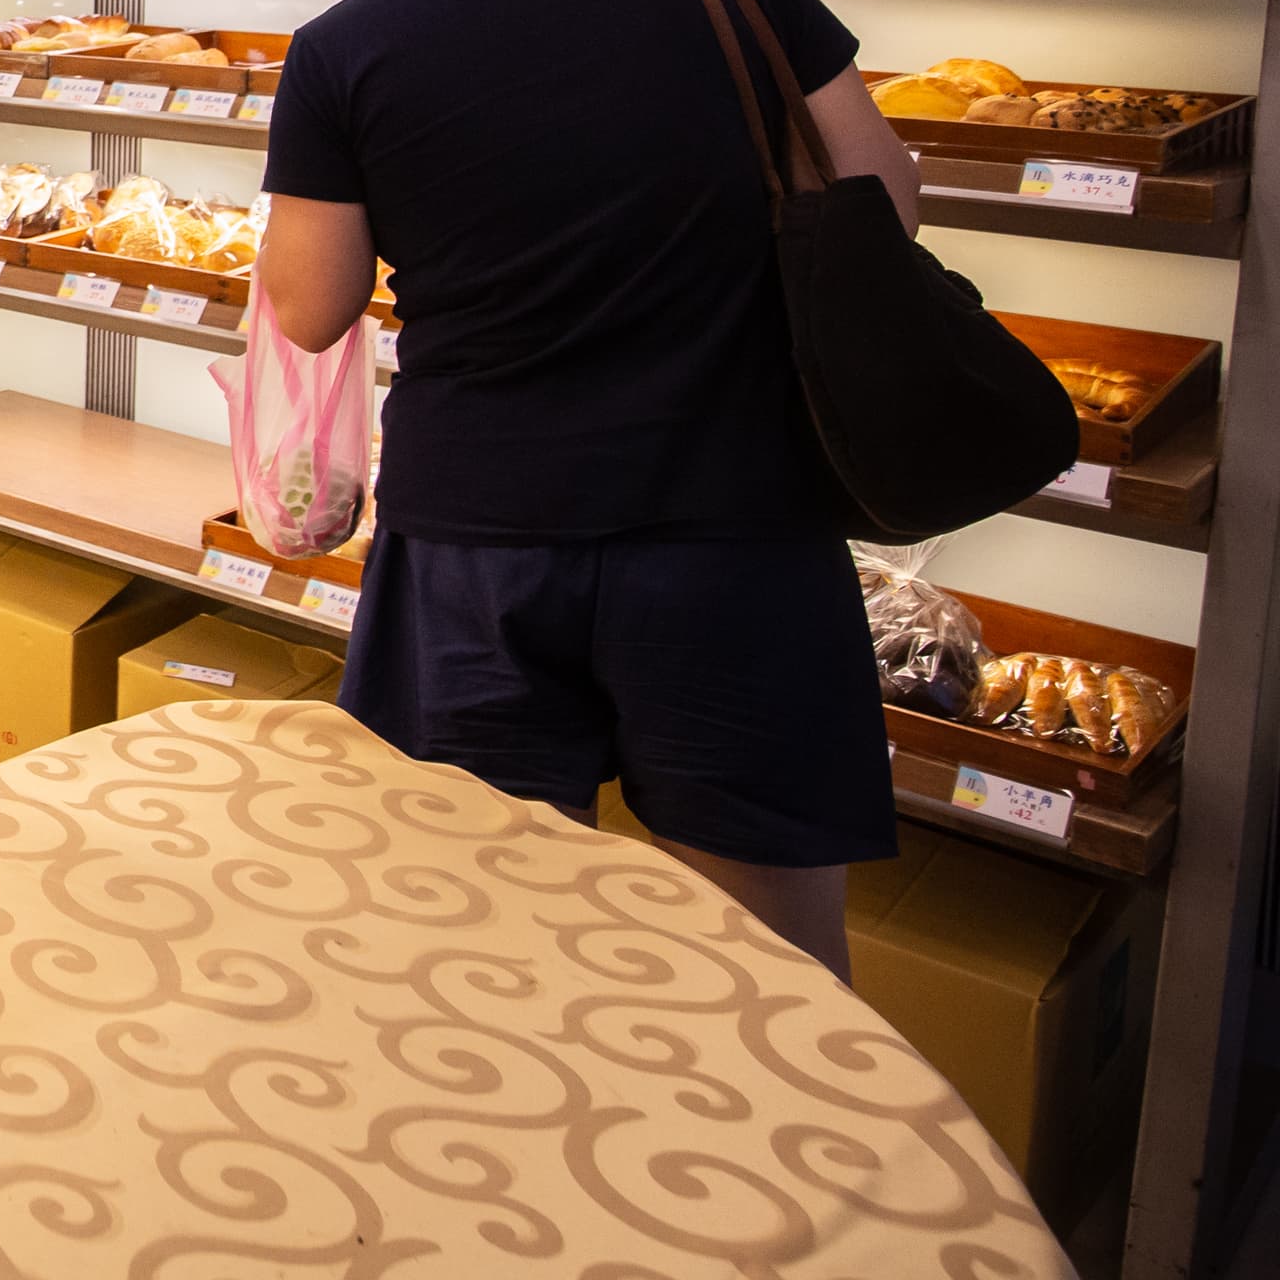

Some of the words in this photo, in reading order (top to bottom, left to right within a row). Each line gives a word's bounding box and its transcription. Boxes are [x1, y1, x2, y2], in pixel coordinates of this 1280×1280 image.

[1062, 171, 1130, 187] 水滴巧克
[1085, 186, 1101, 195] 37
[1003, 785, 1052, 808] 小羊角
